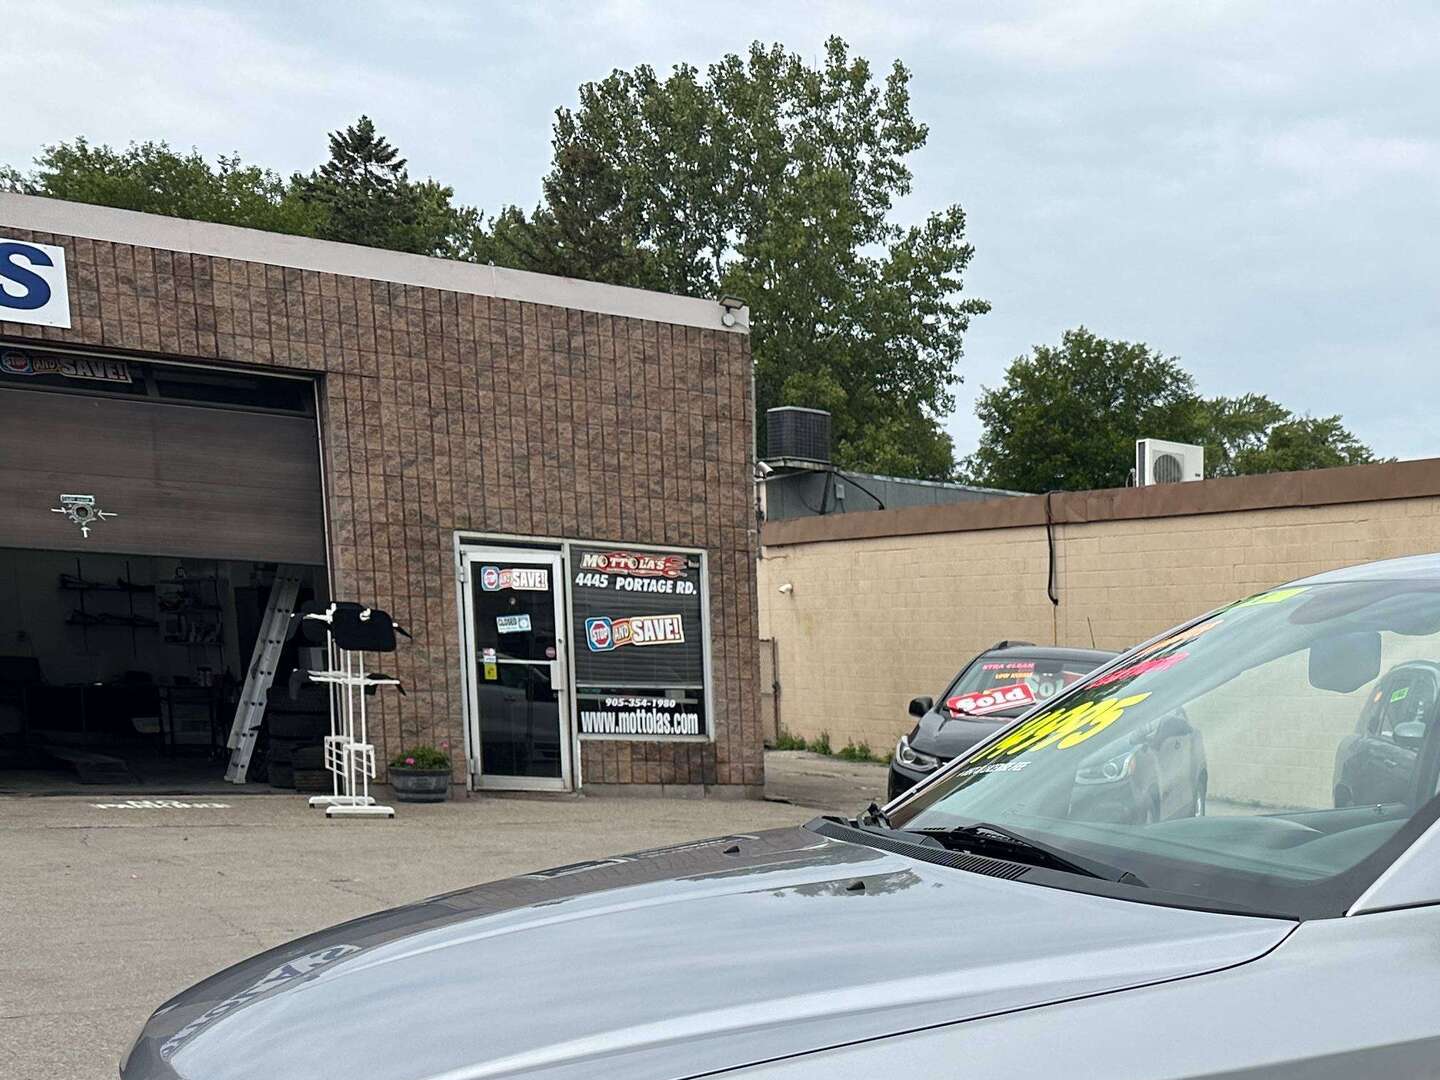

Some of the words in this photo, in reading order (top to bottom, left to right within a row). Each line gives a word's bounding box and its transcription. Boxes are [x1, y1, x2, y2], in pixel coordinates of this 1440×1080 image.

[0, 242, 54, 310] S
[62, 357, 127, 380] SAVE!
[512, 570, 547, 588] SAVE!
[575, 572, 608, 588] 4445
[615, 577, 673, 592] PORTAGE
[676, 582, 697, 595] RD.
[591, 628, 609, 641] STOP
[613, 623, 629, 641] AND
[631, 617, 681, 642] SAVE!
[606, 698, 676, 708] 905-354-1980
[581, 708, 699, 735] www.mottolas.com
